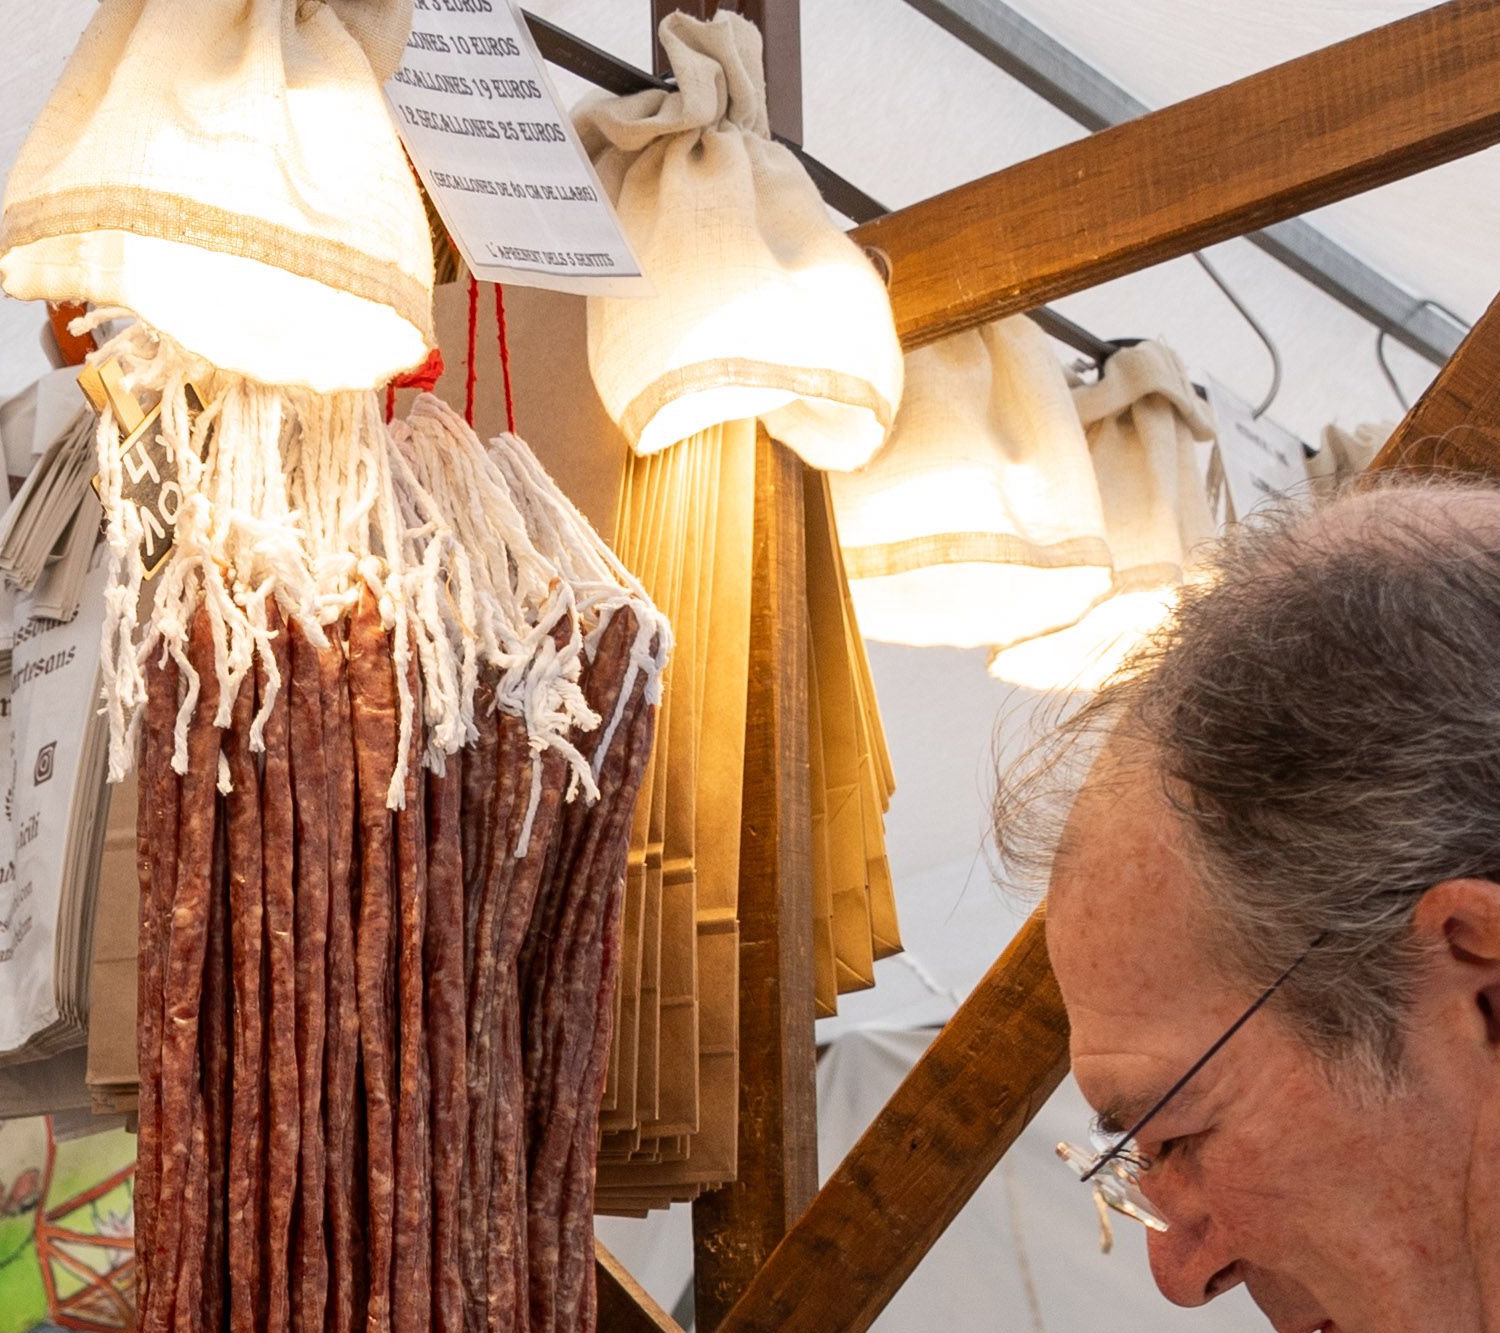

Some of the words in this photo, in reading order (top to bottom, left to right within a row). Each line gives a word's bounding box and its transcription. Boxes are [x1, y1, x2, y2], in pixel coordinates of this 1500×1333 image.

[450, 36, 471, 54] 10
[469, 37, 520, 57] EUROS
[472, 78, 493, 100] 19
[491, 79, 542, 99] EUROS
[417, 110, 500, 139] SECALLONES
[500, 121, 518, 141] 25
[519, 123, 566, 143] EUROS
